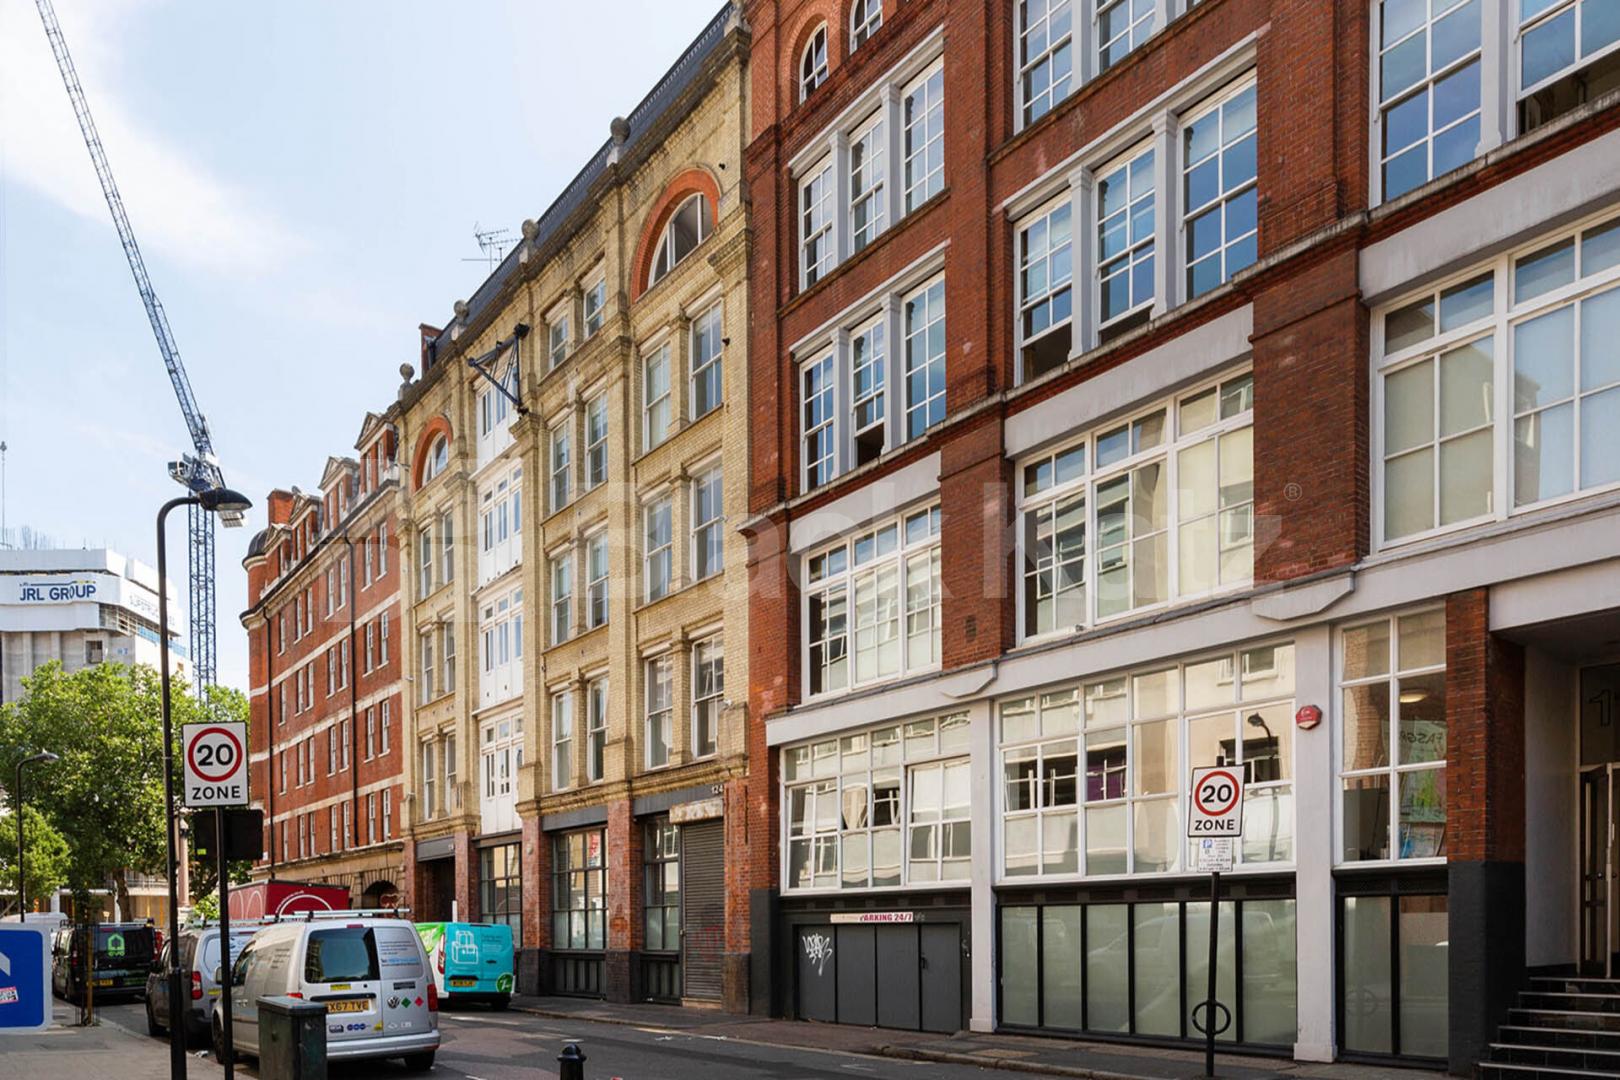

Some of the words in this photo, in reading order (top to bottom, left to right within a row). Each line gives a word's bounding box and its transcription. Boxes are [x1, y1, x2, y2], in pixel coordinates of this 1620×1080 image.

[20, 587, 45, 601] JRL
[49, 584, 97, 601] GROUP
[197, 743, 233, 767] 20
[192, 785, 241, 800] ZONE
[711, 784, 724, 794] 124
[1202, 784, 1232, 803] 20
[1195, 819, 1235, 831] ZONE
[894, 913, 912, 922] 24/7
[326, 1001, 348, 1012] X67
